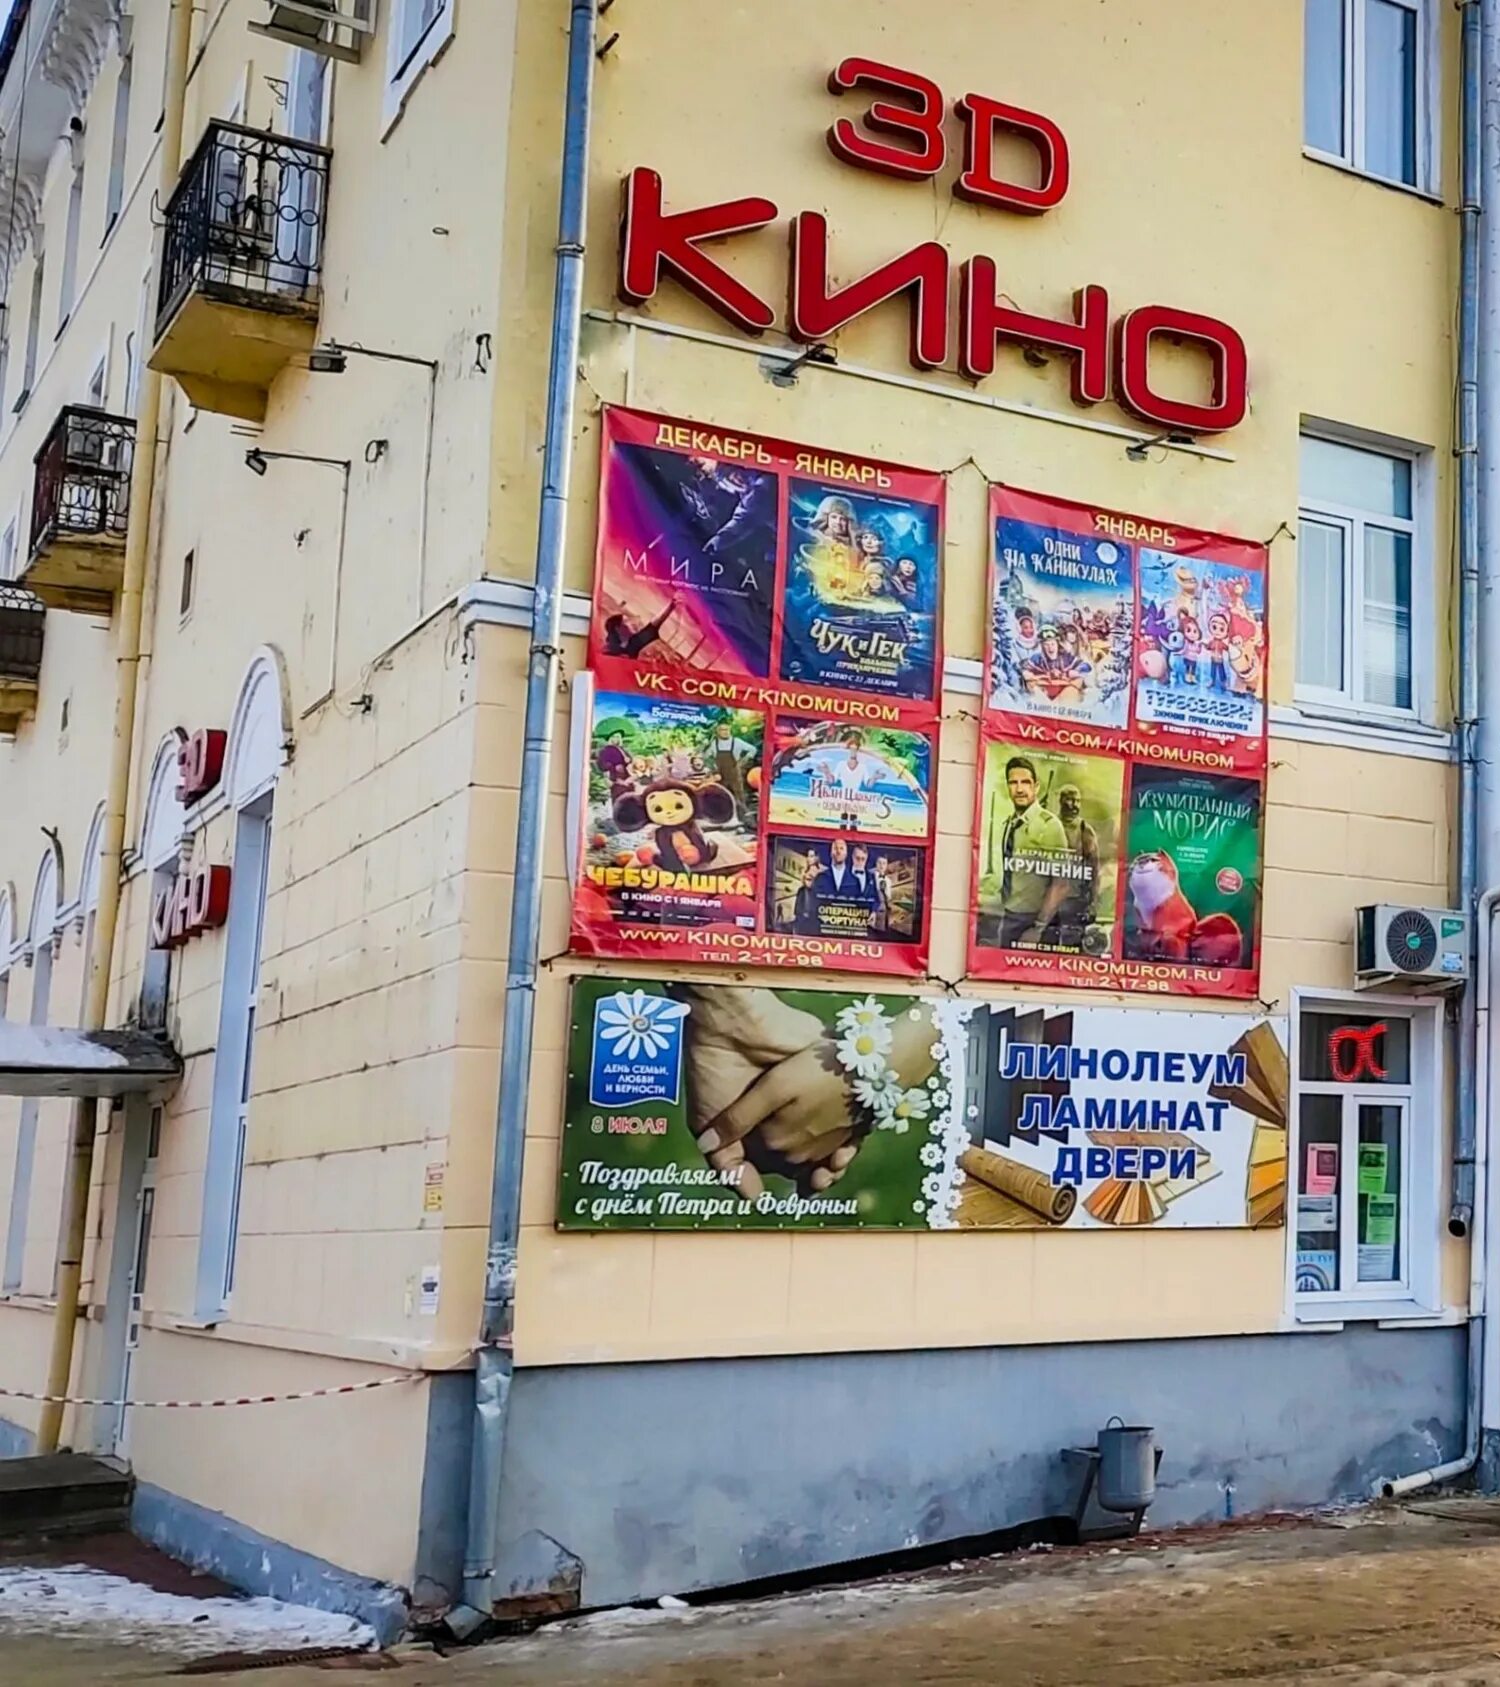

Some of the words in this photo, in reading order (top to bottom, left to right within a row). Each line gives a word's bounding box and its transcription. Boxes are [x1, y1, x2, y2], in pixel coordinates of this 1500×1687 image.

[826, 56, 1070, 216] 3D
[617, 165, 1249, 436] КИНО
[655, 423, 773, 465] ДЕКАБРЬ
[795, 452, 893, 489] ЯНВАРЬ
[1094, 513, 1177, 548] ЯНВАРЬ
[623, 548, 759, 590] МИРА
[1003, 548, 1027, 570] НА
[682, 677, 737, 700] COM
[758, 688, 900, 722] KINOMUROM
[1056, 729, 1100, 750] COM
[1117, 739, 1234, 769] KINOMUROM
[1153, 809, 1237, 842] МОРИС
[587, 864, 754, 897] ЧЕБУРАШКА
[1004, 856, 1093, 881] КРУШЕНИЕ
[737, 950, 824, 967] 2-17-98
[1099, 975, 1170, 992] 2-17-98
[603, 1063, 630, 1074] ДЕНЬ
[617, 1074, 655, 1084] ЛЮБВИ
[1001, 1041, 1247, 1086] ЛИНОЛЕУМ
[615, 1084, 666, 1094] ВЕРНОСТИ
[591, 1115, 604, 1134] 8
[608, 1115, 668, 1135] ИЮЛЯ
[1018, 1094, 1230, 1132] ЛАМИНАТ
[579, 1161, 745, 1192] Поздравляем!
[1051, 1146, 1199, 1185] ДВЕРИ
[592, 1194, 653, 1221] днём
[656, 1192, 734, 1221] Петра
[755, 1191, 858, 1221] Февроньи
